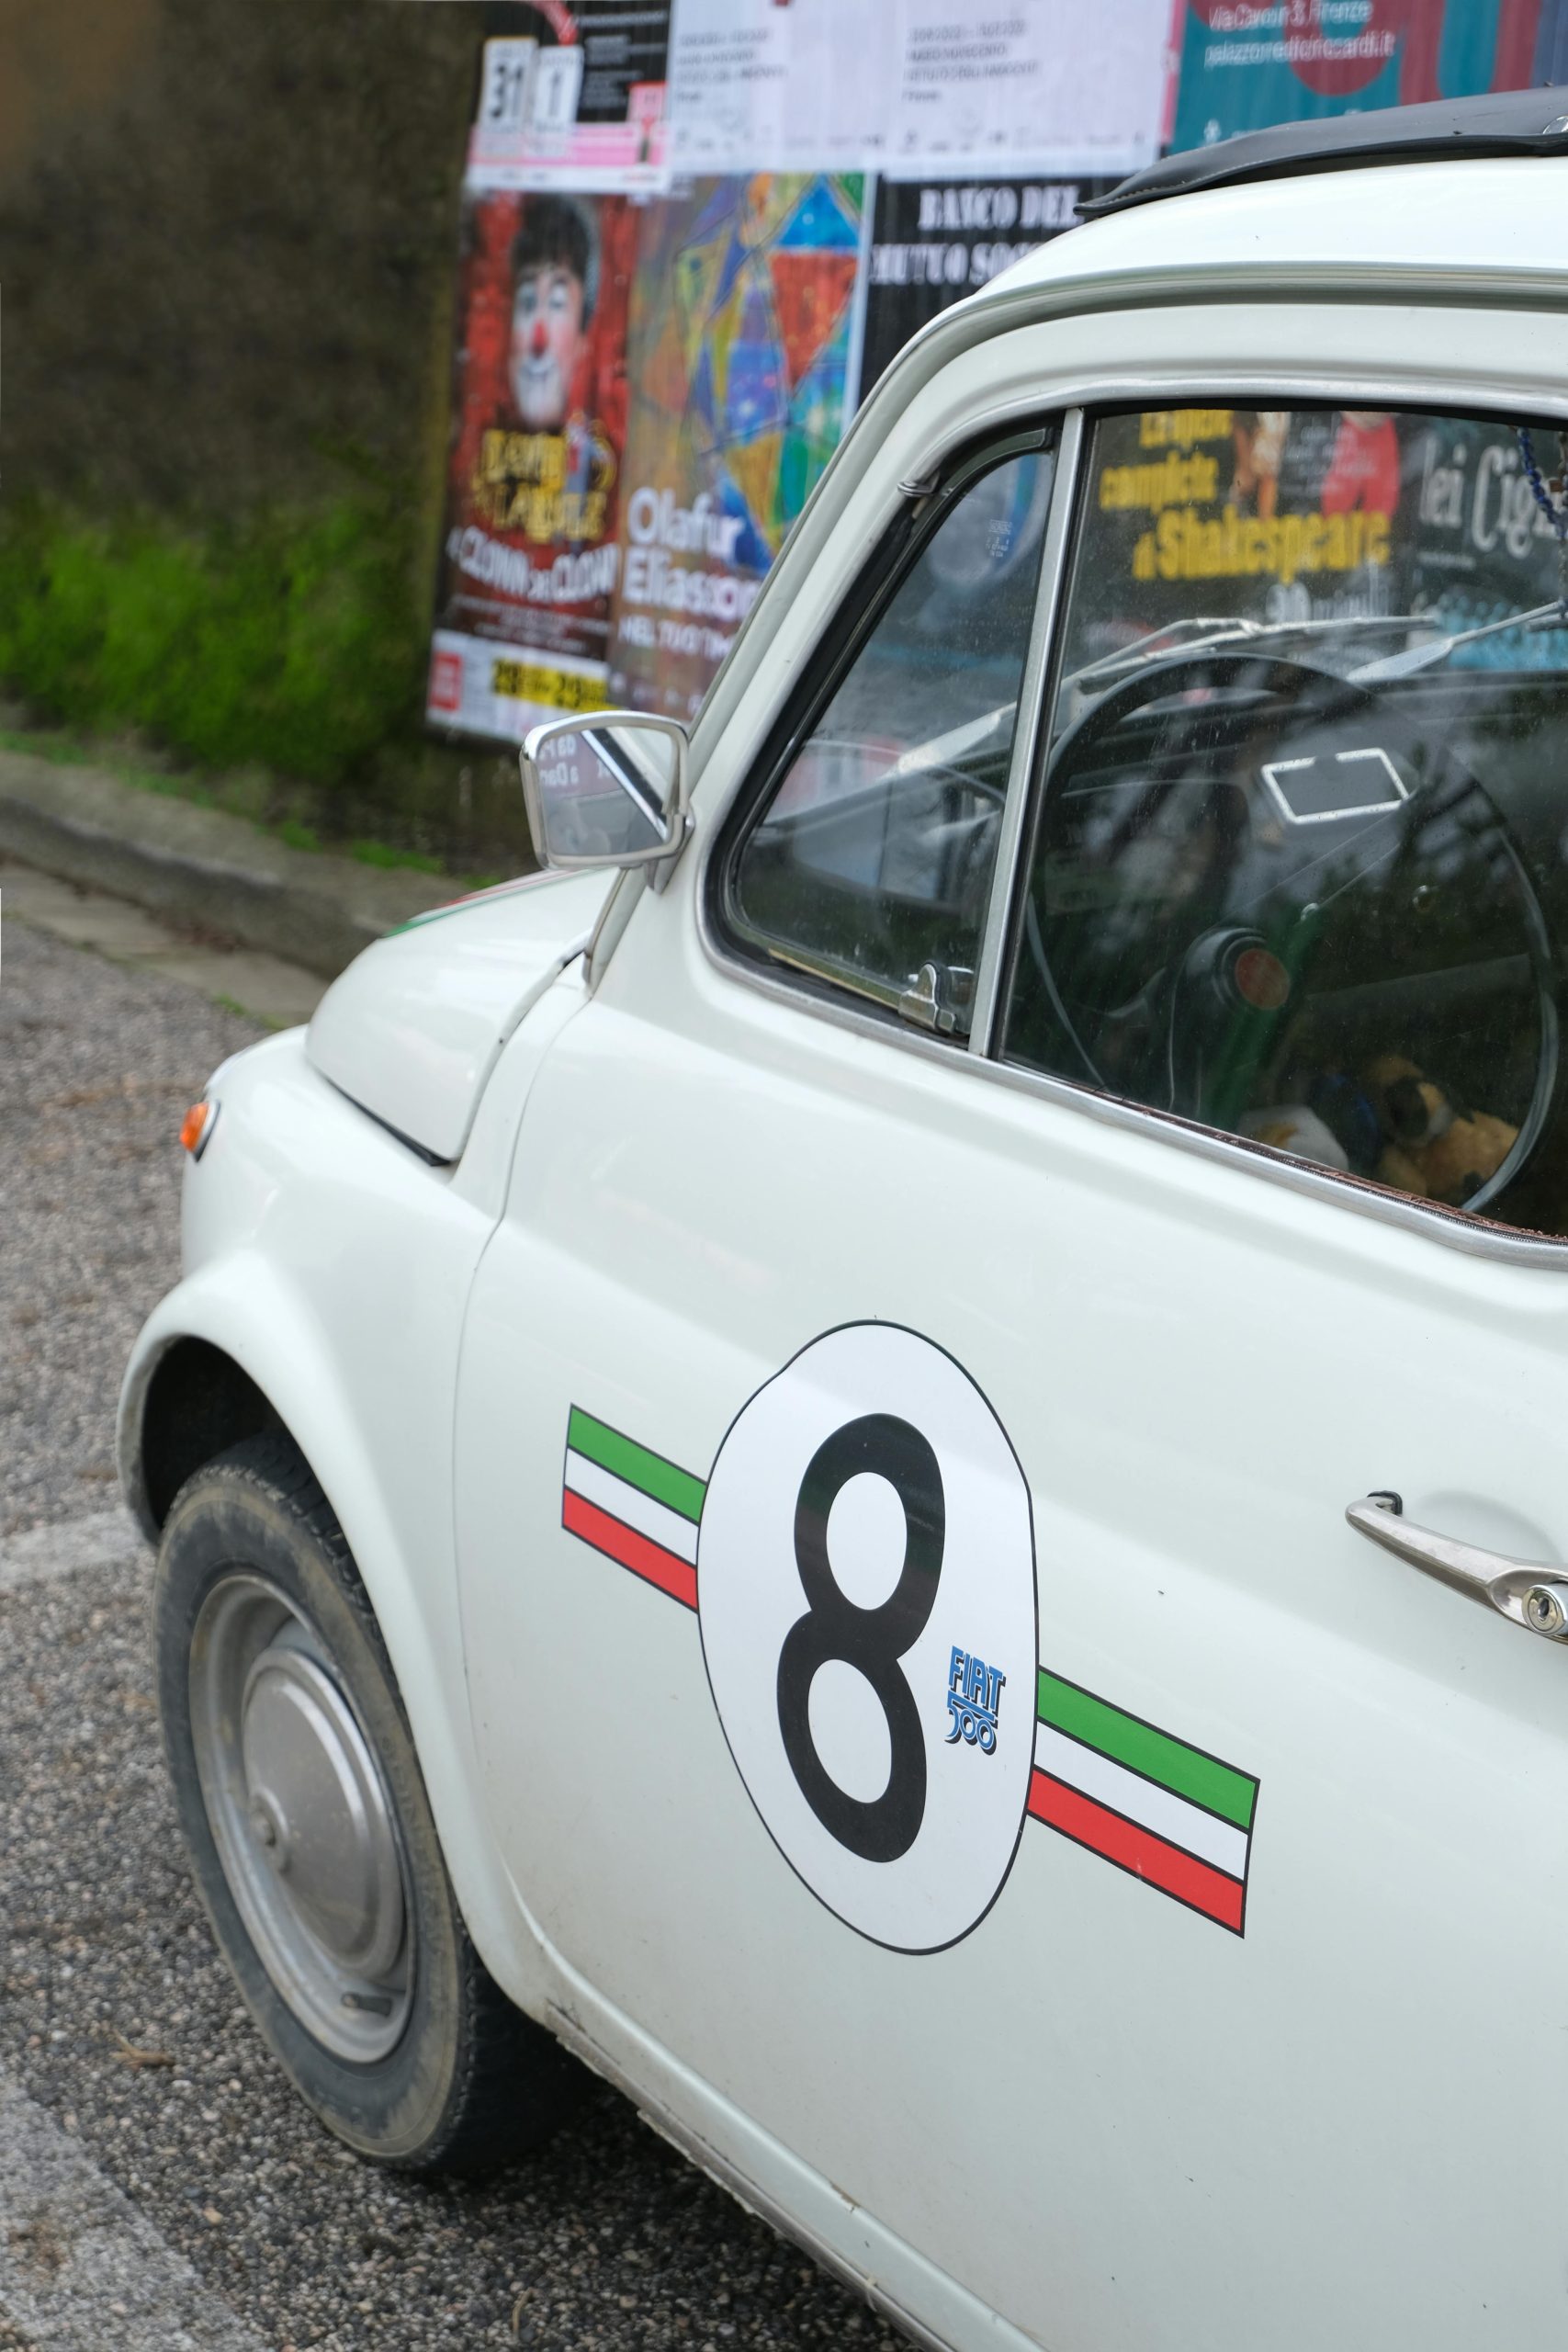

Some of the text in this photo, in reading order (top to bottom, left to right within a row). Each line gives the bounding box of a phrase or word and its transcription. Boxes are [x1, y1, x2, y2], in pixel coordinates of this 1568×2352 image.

[1208, 6, 1234, 31] Via
[1310, 0, 1373, 23] Firenze
[918, 186, 1085, 230] BANCO DEL
[1100, 449, 1220, 516] complete
[627, 487, 747, 559] Olafur
[1156, 503, 1393, 589] Shakespeare
[552, 542, 620, 603] CLOWN
[618, 615, 656, 647] NEL
[777, 1413, 946, 1863] 8
[948, 1645, 1007, 1717] FIAT
[943, 1690, 998, 1756] 500
